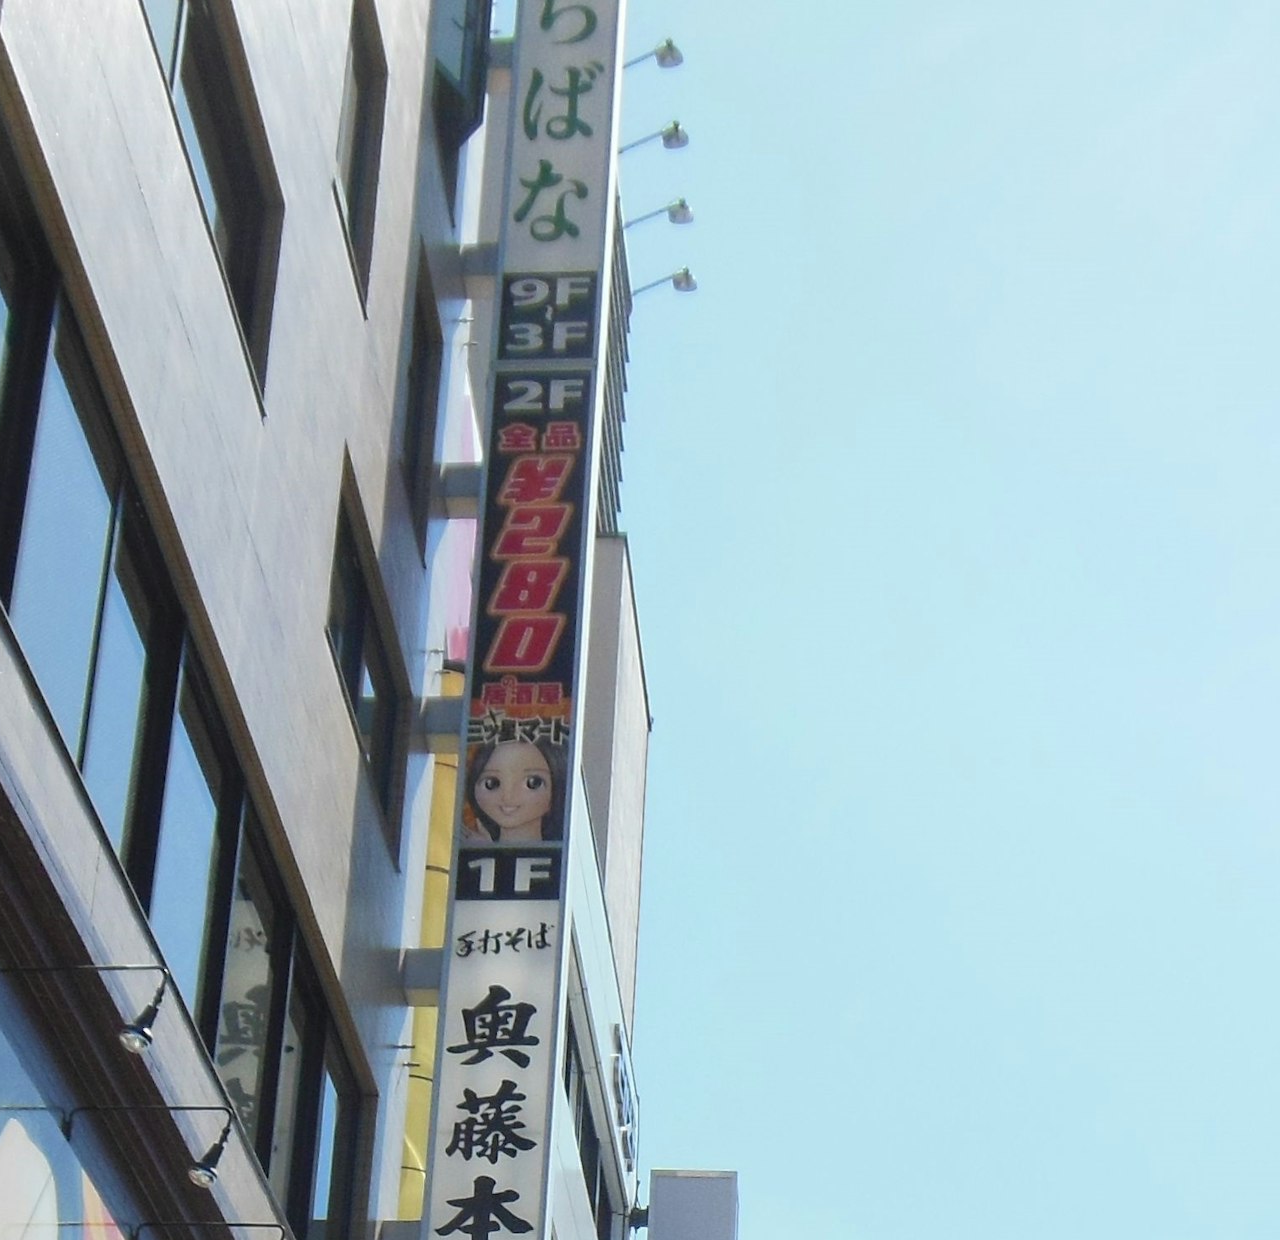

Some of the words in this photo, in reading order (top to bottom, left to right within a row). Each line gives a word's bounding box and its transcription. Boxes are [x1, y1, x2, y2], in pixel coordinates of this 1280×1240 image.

[508, 276, 591, 307] 9F
[505, 321, 588, 352] 3F
[503, 378, 584, 411] 2F
[498, 422, 581, 451] 全品
[467, 857, 552, 893] 1F
[456, 922, 555, 957] 手打そば
